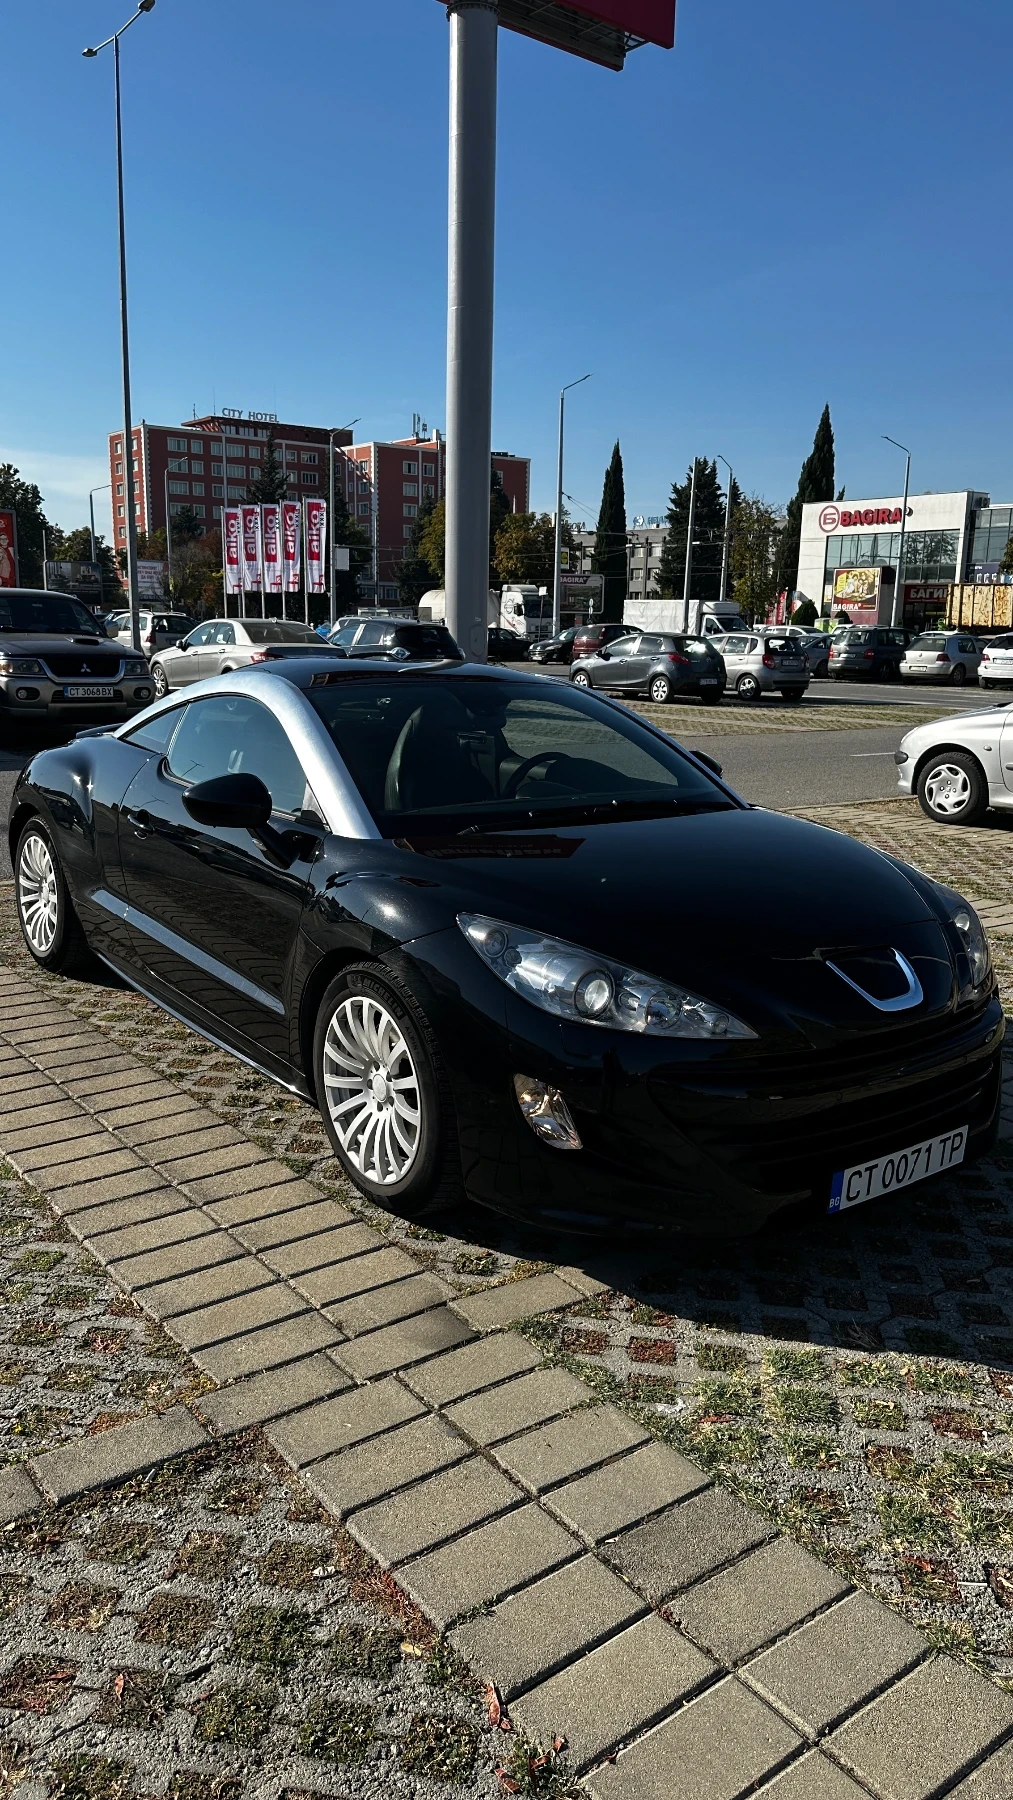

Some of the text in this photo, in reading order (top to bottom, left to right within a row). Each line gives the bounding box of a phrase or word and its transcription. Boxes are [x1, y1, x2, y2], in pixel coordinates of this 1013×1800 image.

[222, 407, 280, 423] CITY HOTEL
[244, 515, 256, 555] aiko
[265, 515, 276, 556] aiko
[285, 512, 295, 553] aiko
[309, 510, 320, 553] aiko
[840, 507, 903, 528] BAGIRA
[226, 519, 238, 558] aiko
[832, 603, 859, 611] BAGIRA
[69, 688, 112, 697] CT 3068 BX
[362, 978, 405, 1019] MICHELIN
[829, 1131, 964, 1208] BG CT 0071 TP
